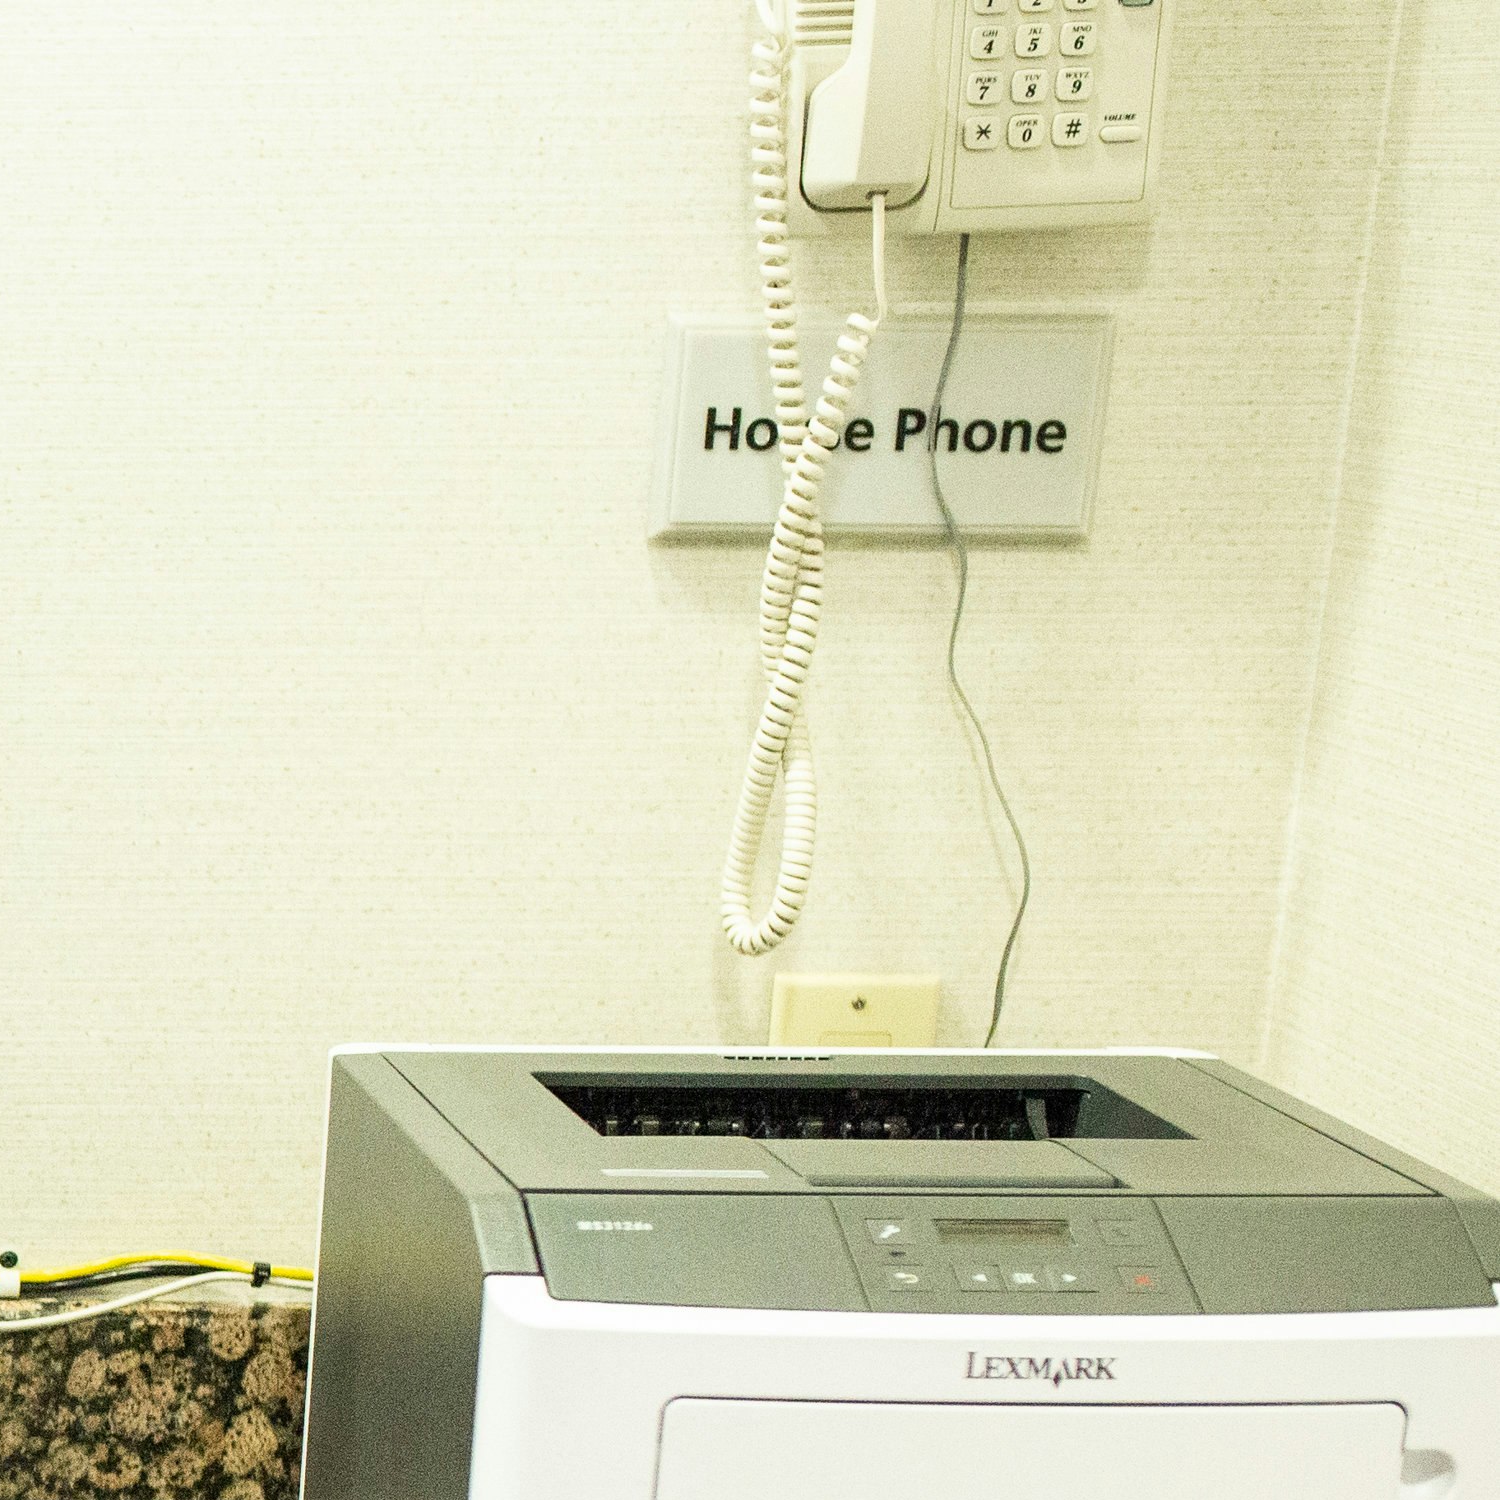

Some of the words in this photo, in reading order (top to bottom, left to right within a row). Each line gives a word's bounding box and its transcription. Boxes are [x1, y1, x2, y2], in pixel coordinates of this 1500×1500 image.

[983, 40, 994, 54] 4
[1027, 37, 1040, 52] 5
[1073, 35, 1085, 50] 6
[979, 86, 990, 100] 7
[1024, 84, 1037, 98] 8
[1070, 80, 1083, 94] 9
[1103, 113, 1137, 122] VOLUME
[1021, 127, 1032, 142] 0
[703, 406, 875, 452] Hoe
[894, 405, 1068, 453] Phone
[965, 1351, 1118, 1388] LEXMARK
